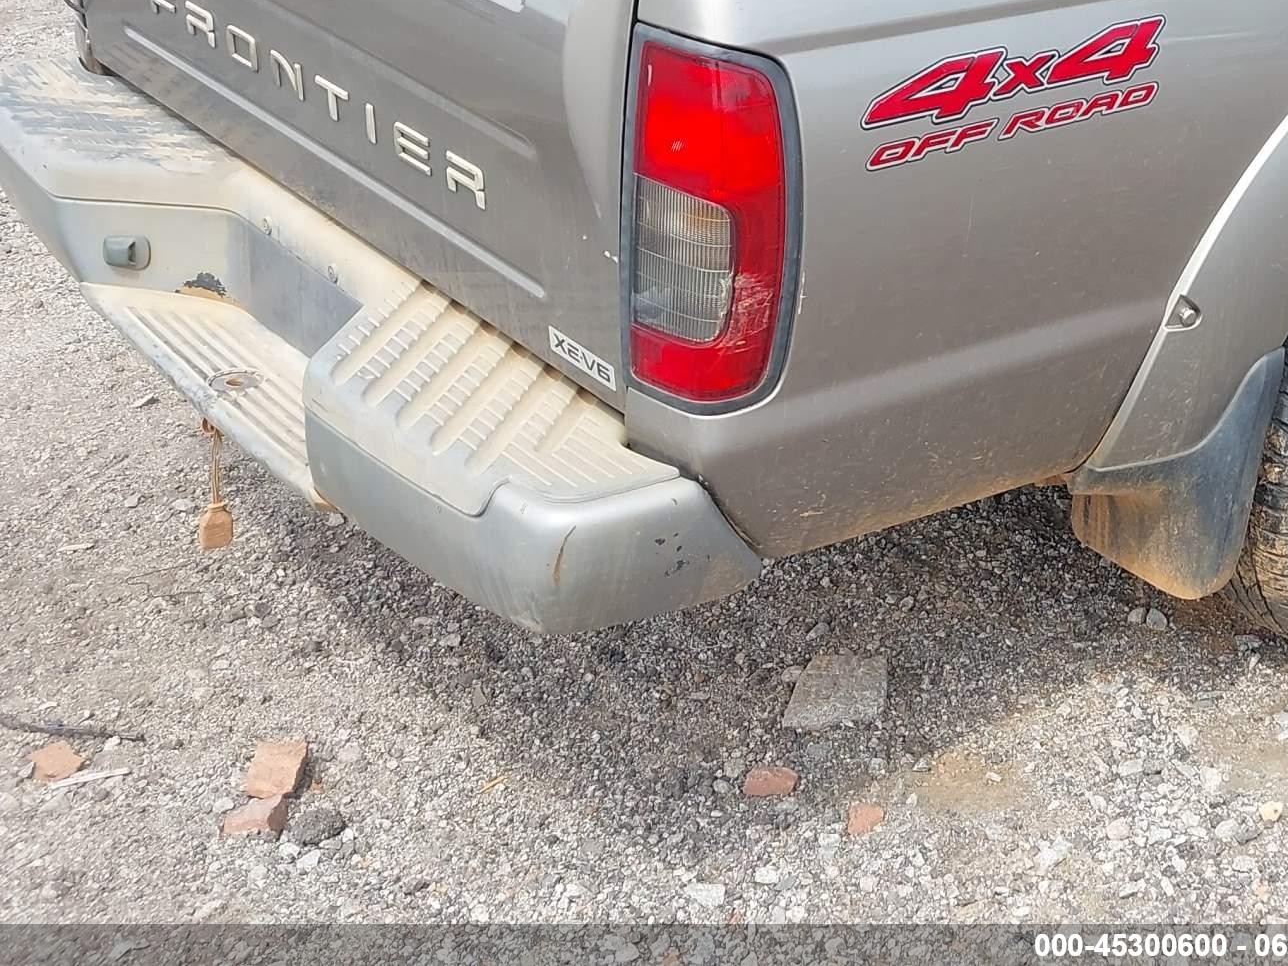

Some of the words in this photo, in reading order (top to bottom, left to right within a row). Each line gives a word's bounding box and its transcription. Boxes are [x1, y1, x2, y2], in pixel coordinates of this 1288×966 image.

[861, 14, 1167, 130] 4x4
[866, 117, 1000, 172] OFF
[998, 81, 1160, 142] ROAD
